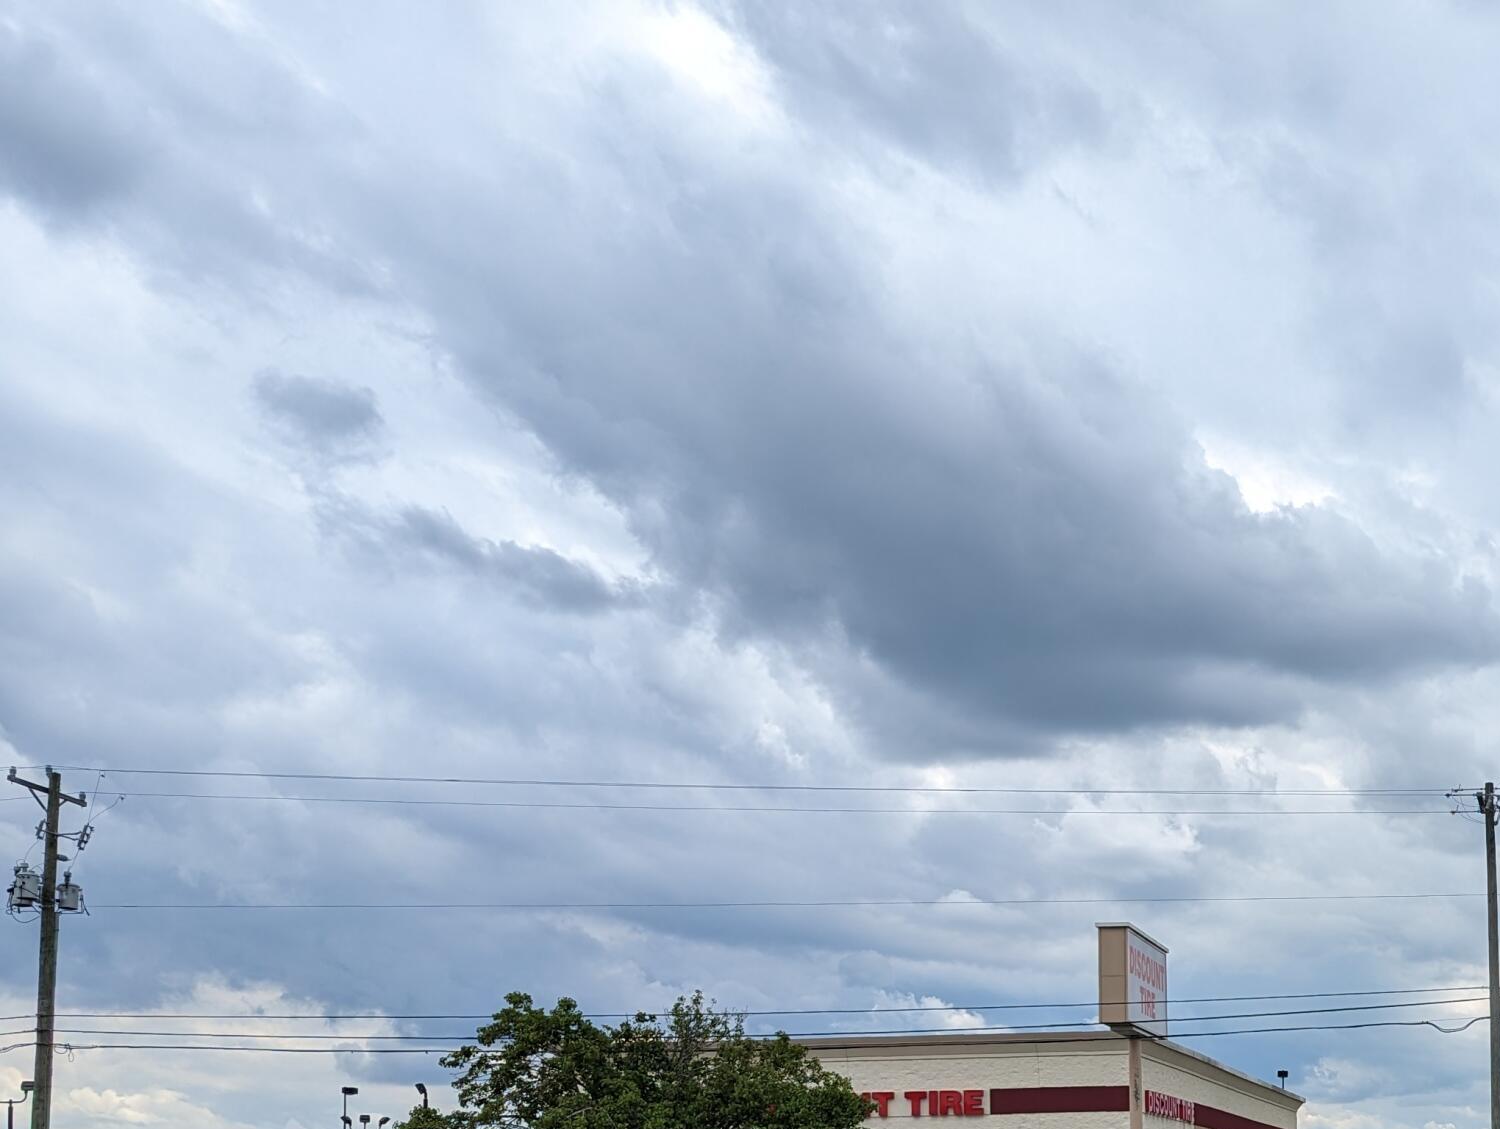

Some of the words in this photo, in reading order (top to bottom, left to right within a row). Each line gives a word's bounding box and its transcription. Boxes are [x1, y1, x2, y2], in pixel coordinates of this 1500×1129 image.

[1129, 945, 1164, 993] DISCOUNT
[1140, 986, 1156, 1020] TIRE
[904, 1090, 985, 1118] TIRE
[1148, 1091, 1181, 1121] DISCOUNT
